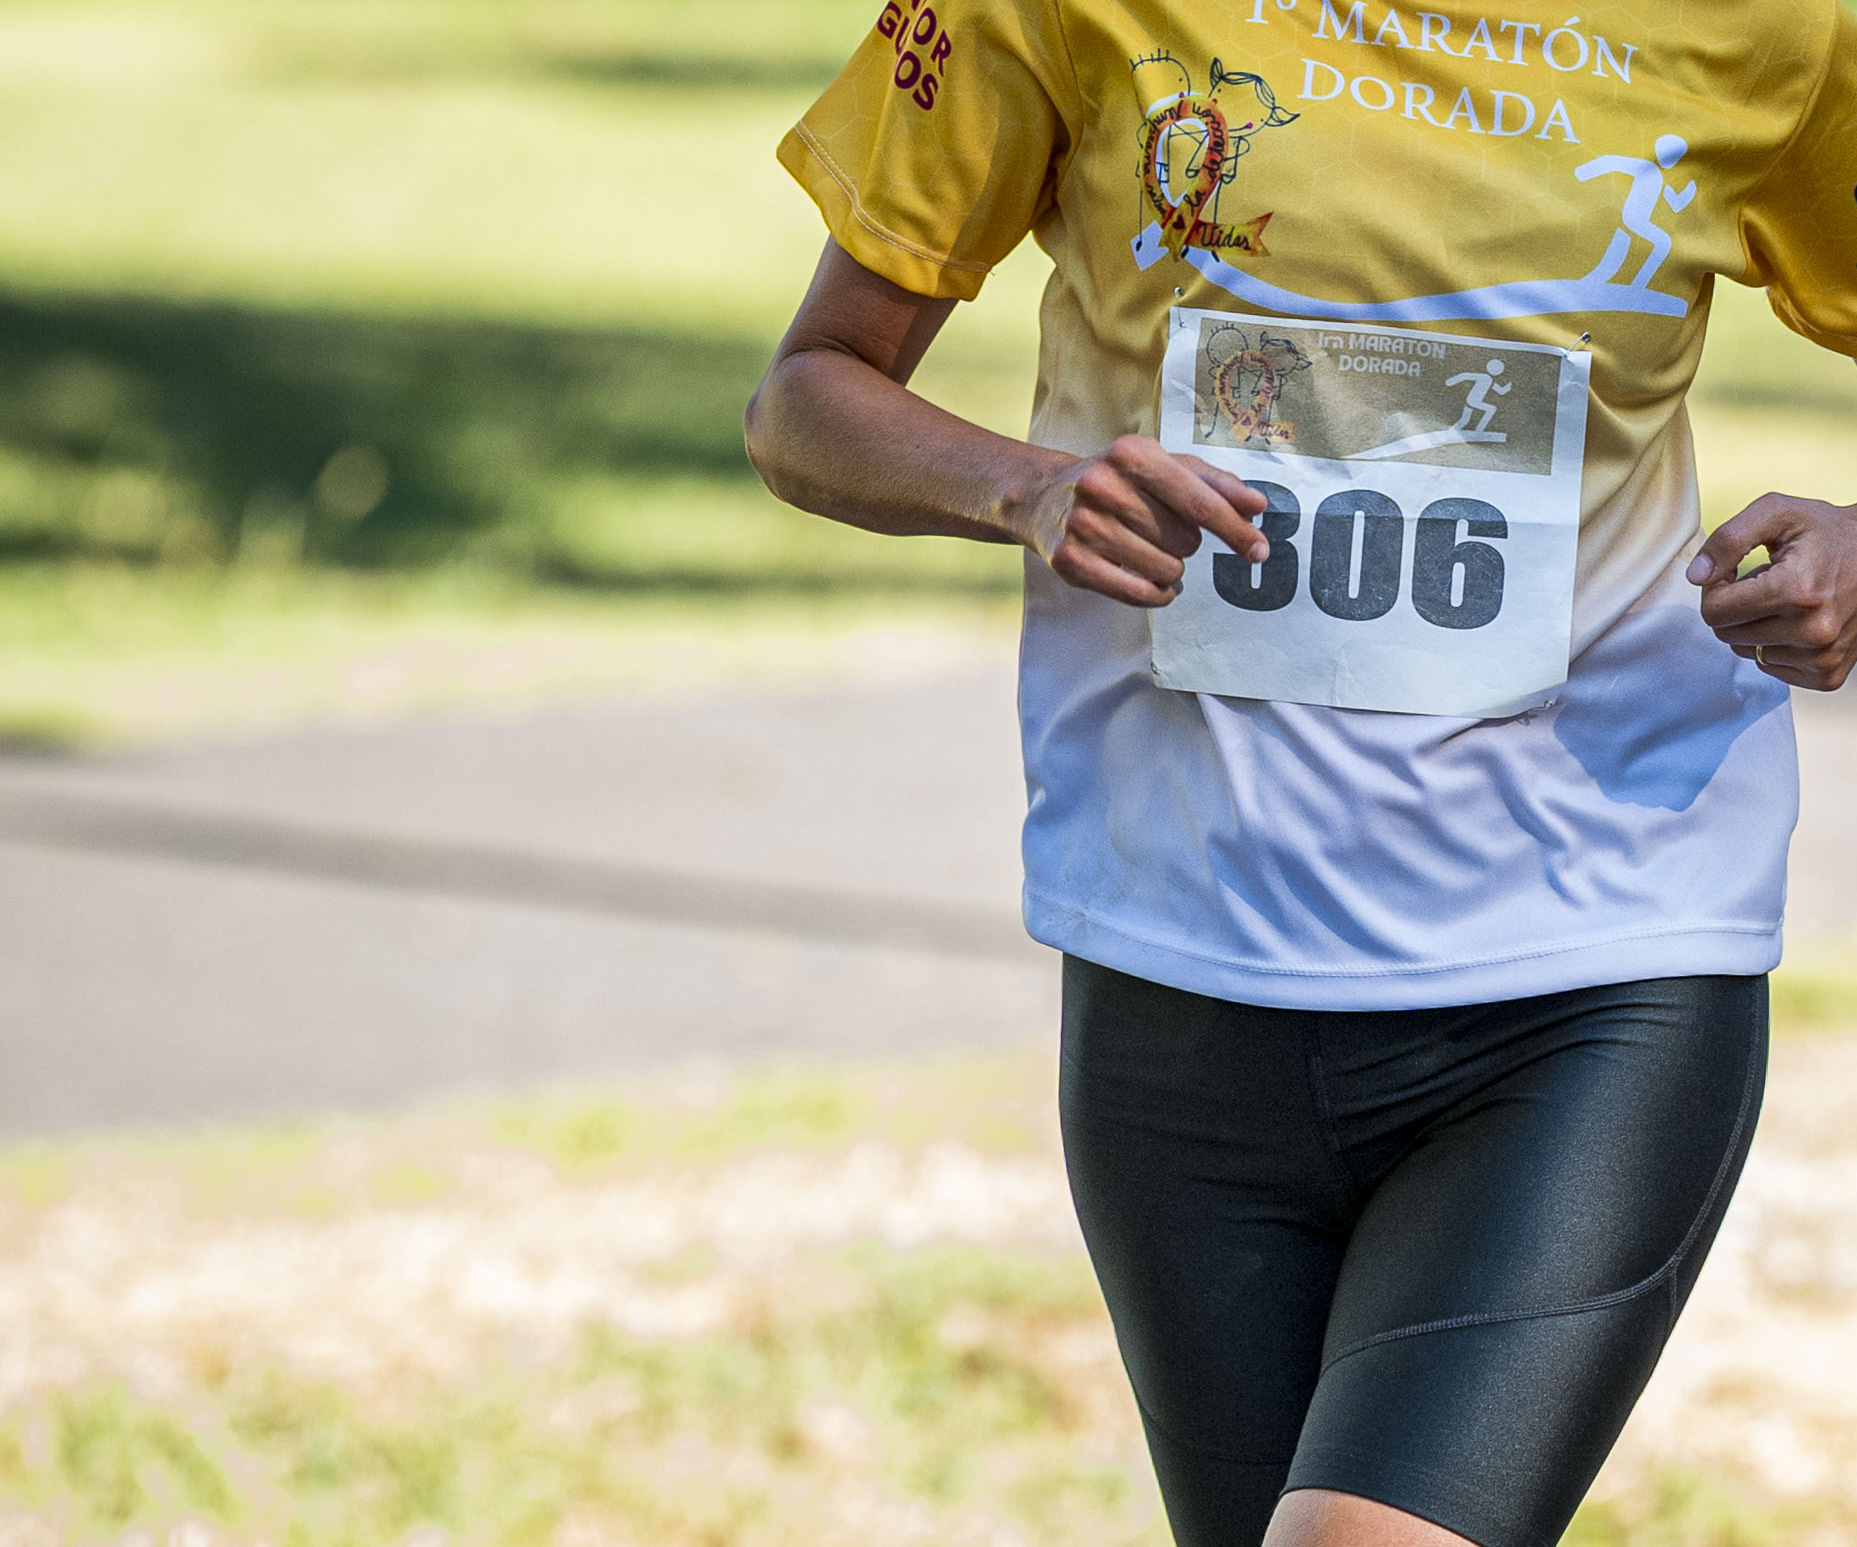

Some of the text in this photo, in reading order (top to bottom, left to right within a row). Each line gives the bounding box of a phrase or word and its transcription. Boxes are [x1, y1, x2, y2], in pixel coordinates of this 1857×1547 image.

[1297, 58, 1581, 144] DORADA
[1339, 354, 1421, 377] DORADA
[1212, 480, 1509, 630] 306
